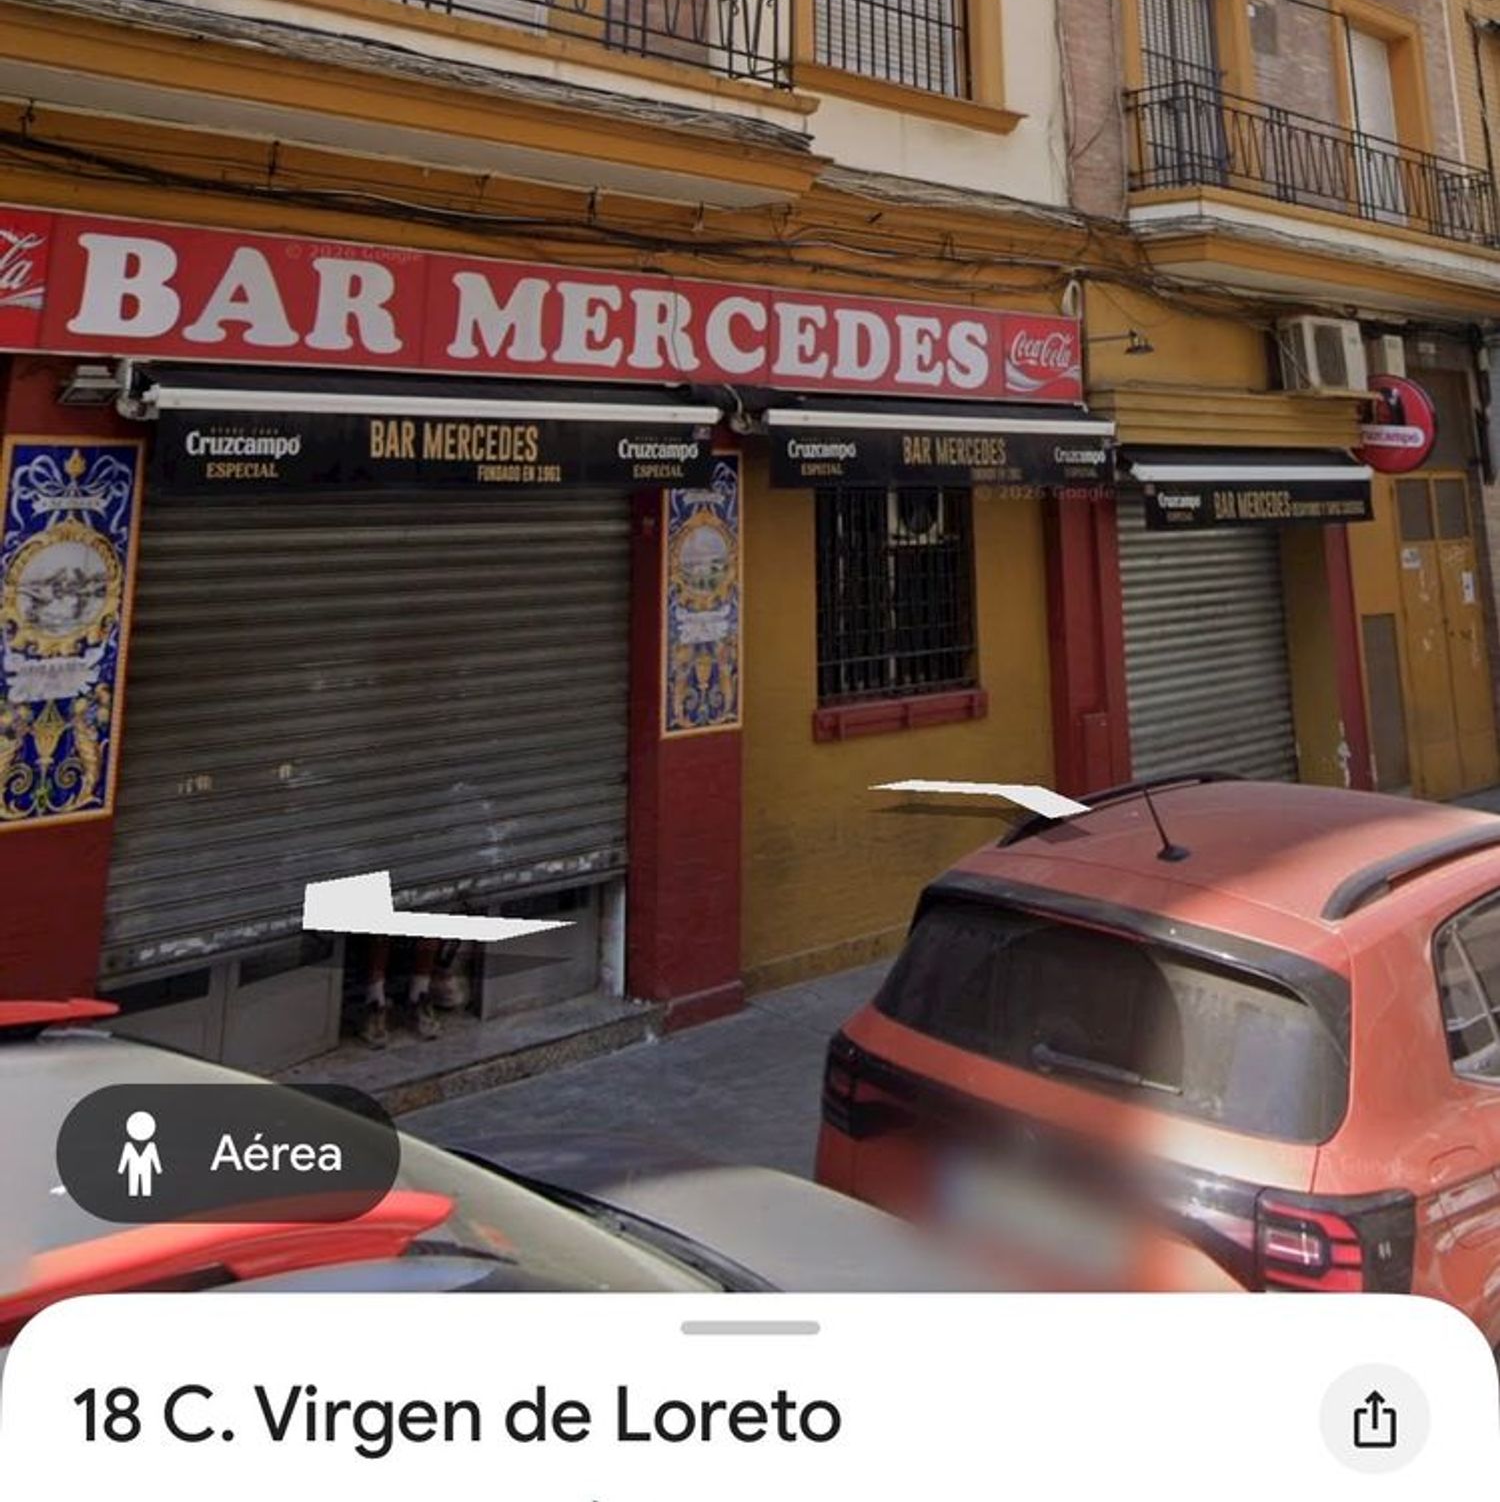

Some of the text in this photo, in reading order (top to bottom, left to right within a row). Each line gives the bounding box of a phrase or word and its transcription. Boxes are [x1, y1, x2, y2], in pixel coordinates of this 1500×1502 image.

[66, 232, 403, 354] BAR
[446, 270, 991, 391] MERCEDES
[186, 430, 301, 459] Cruzcampo
[369, 419, 539, 463] BAR MERCEDES
[618, 438, 699, 462] Cruzcampo
[788, 439, 857, 460] Cruzcampo
[903, 436, 1007, 466] BAR MERCEDES
[206, 462, 279, 478] ESPECIAL
[632, 463, 685, 479] ESPECIAL
